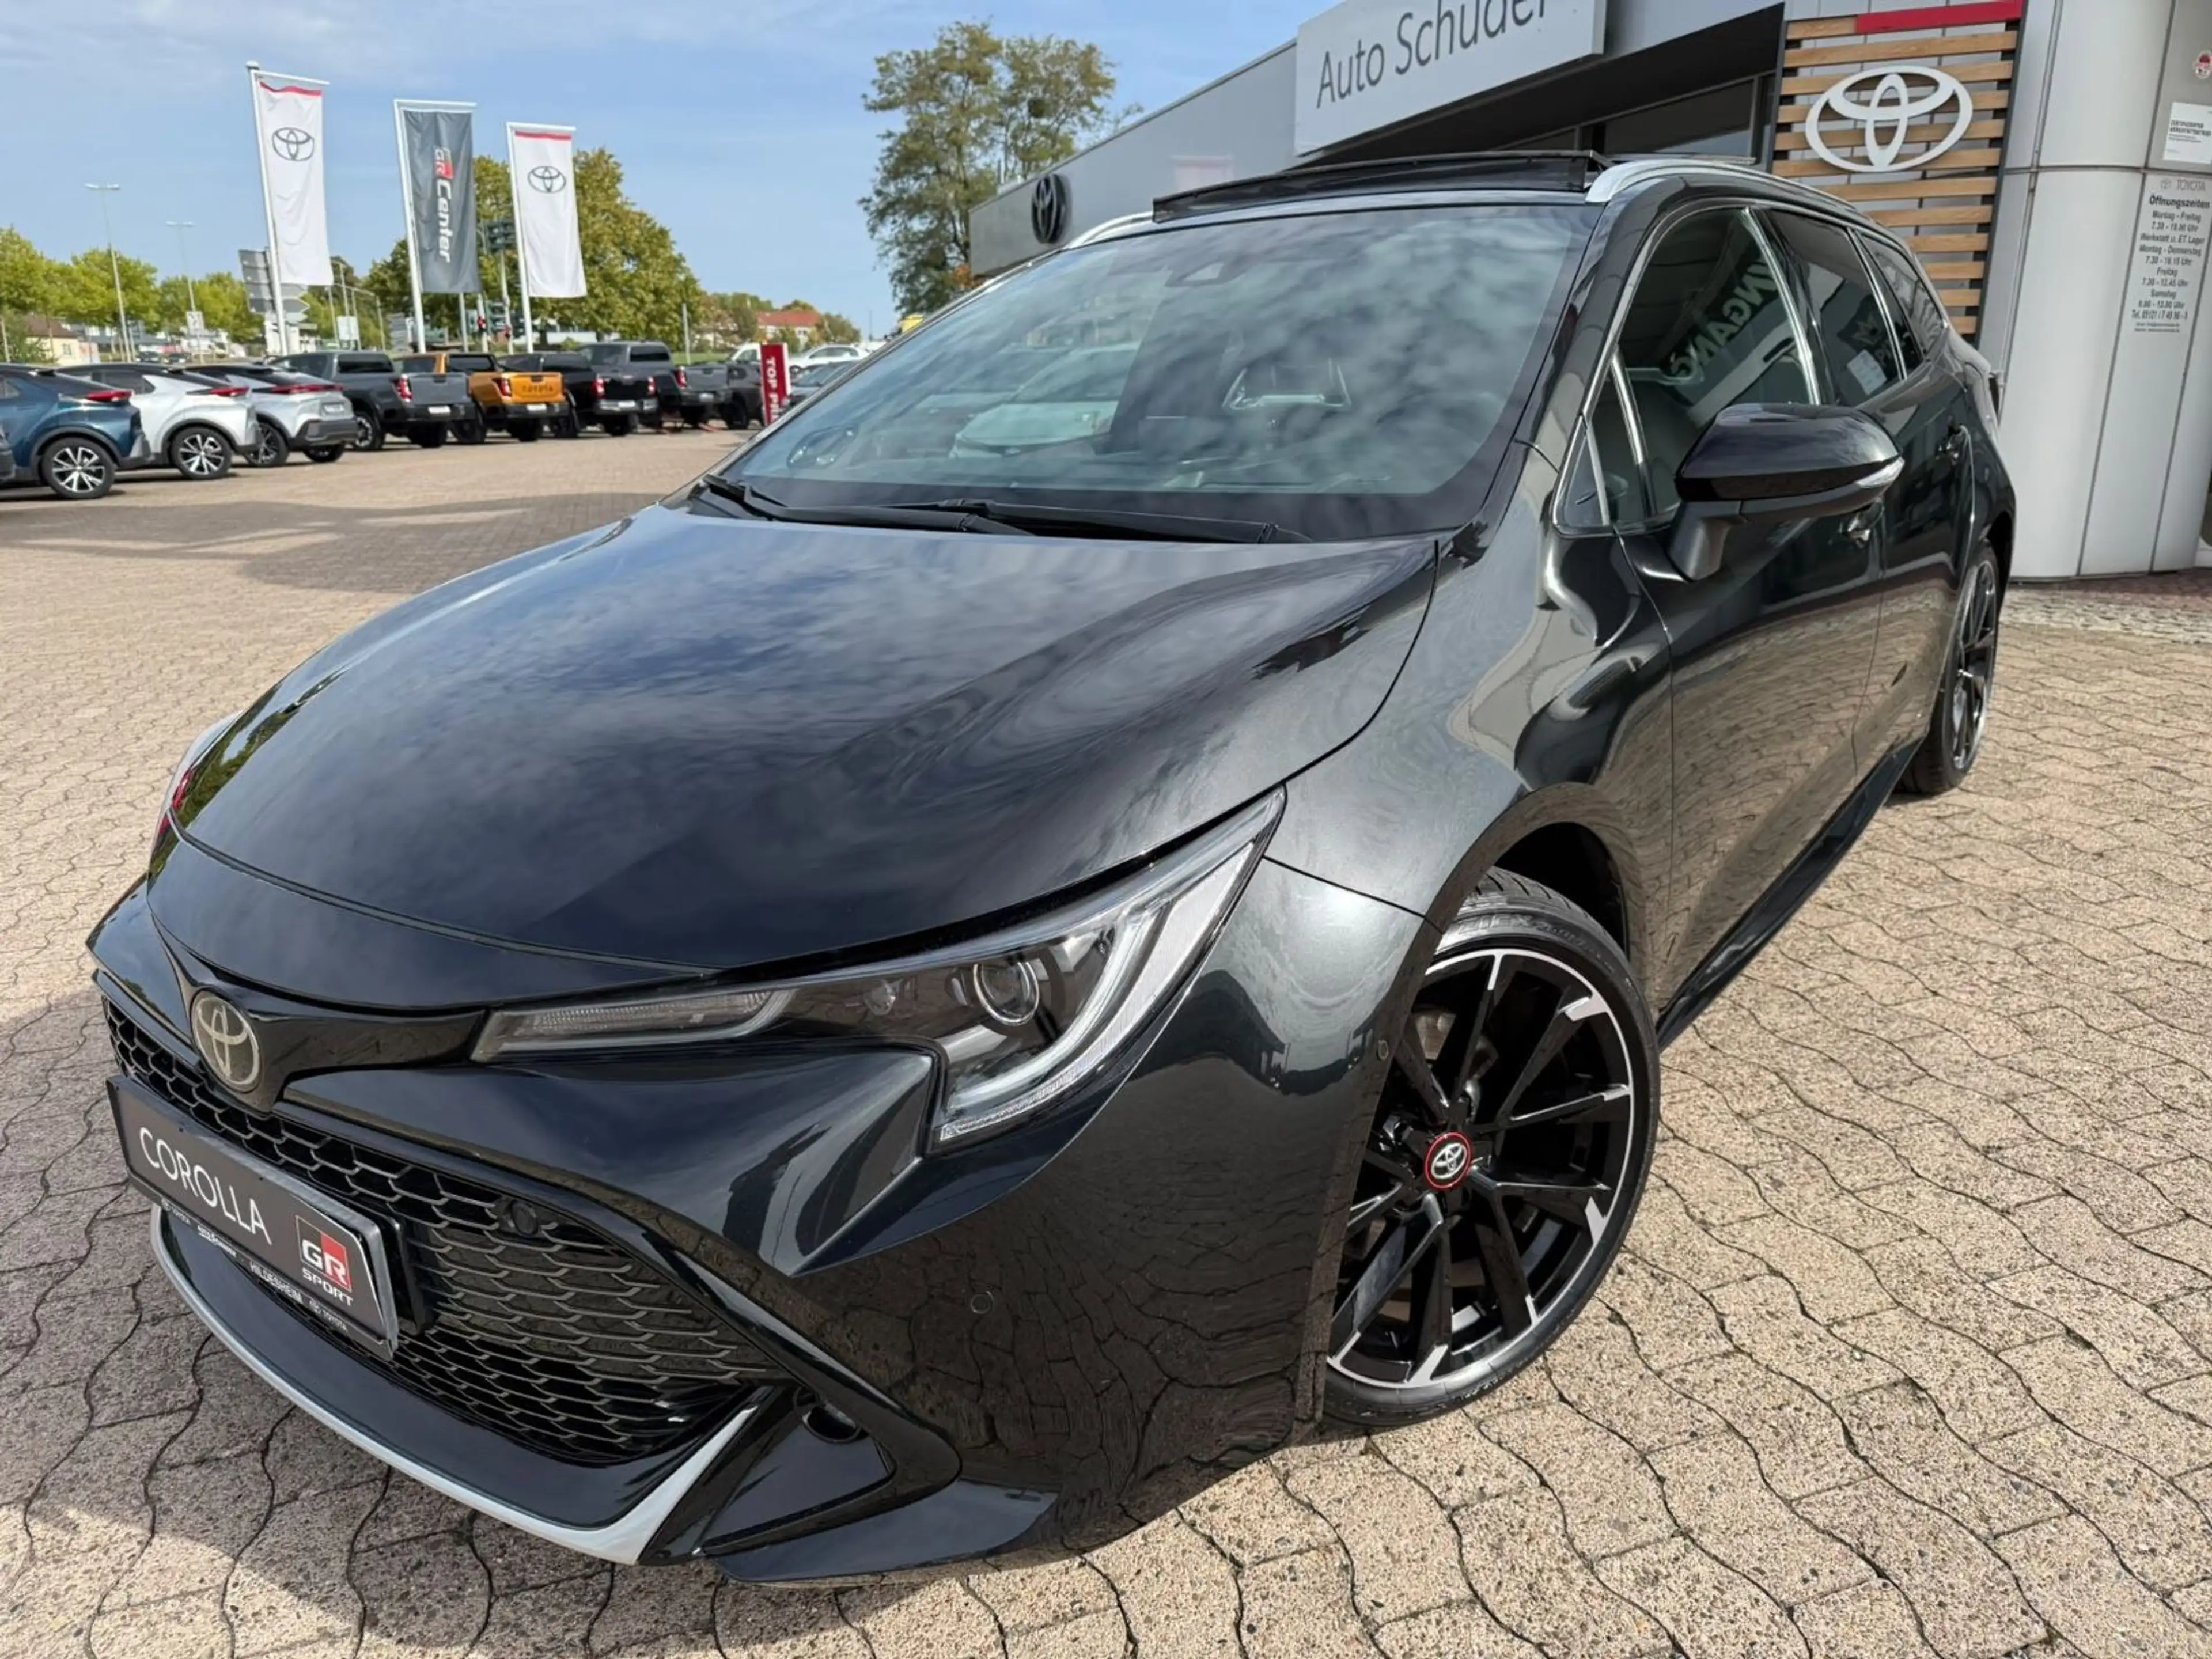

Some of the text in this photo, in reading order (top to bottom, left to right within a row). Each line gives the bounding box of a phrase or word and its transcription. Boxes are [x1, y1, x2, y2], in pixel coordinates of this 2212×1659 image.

[1316, 39, 1384, 109] Auto
[437, 179, 453, 263] Center
[766, 357, 778, 389] TOP
[139, 1127, 273, 1245] COROLLA
[300, 1238, 349, 1286] GR
[302, 1267, 354, 1307] SPORT
